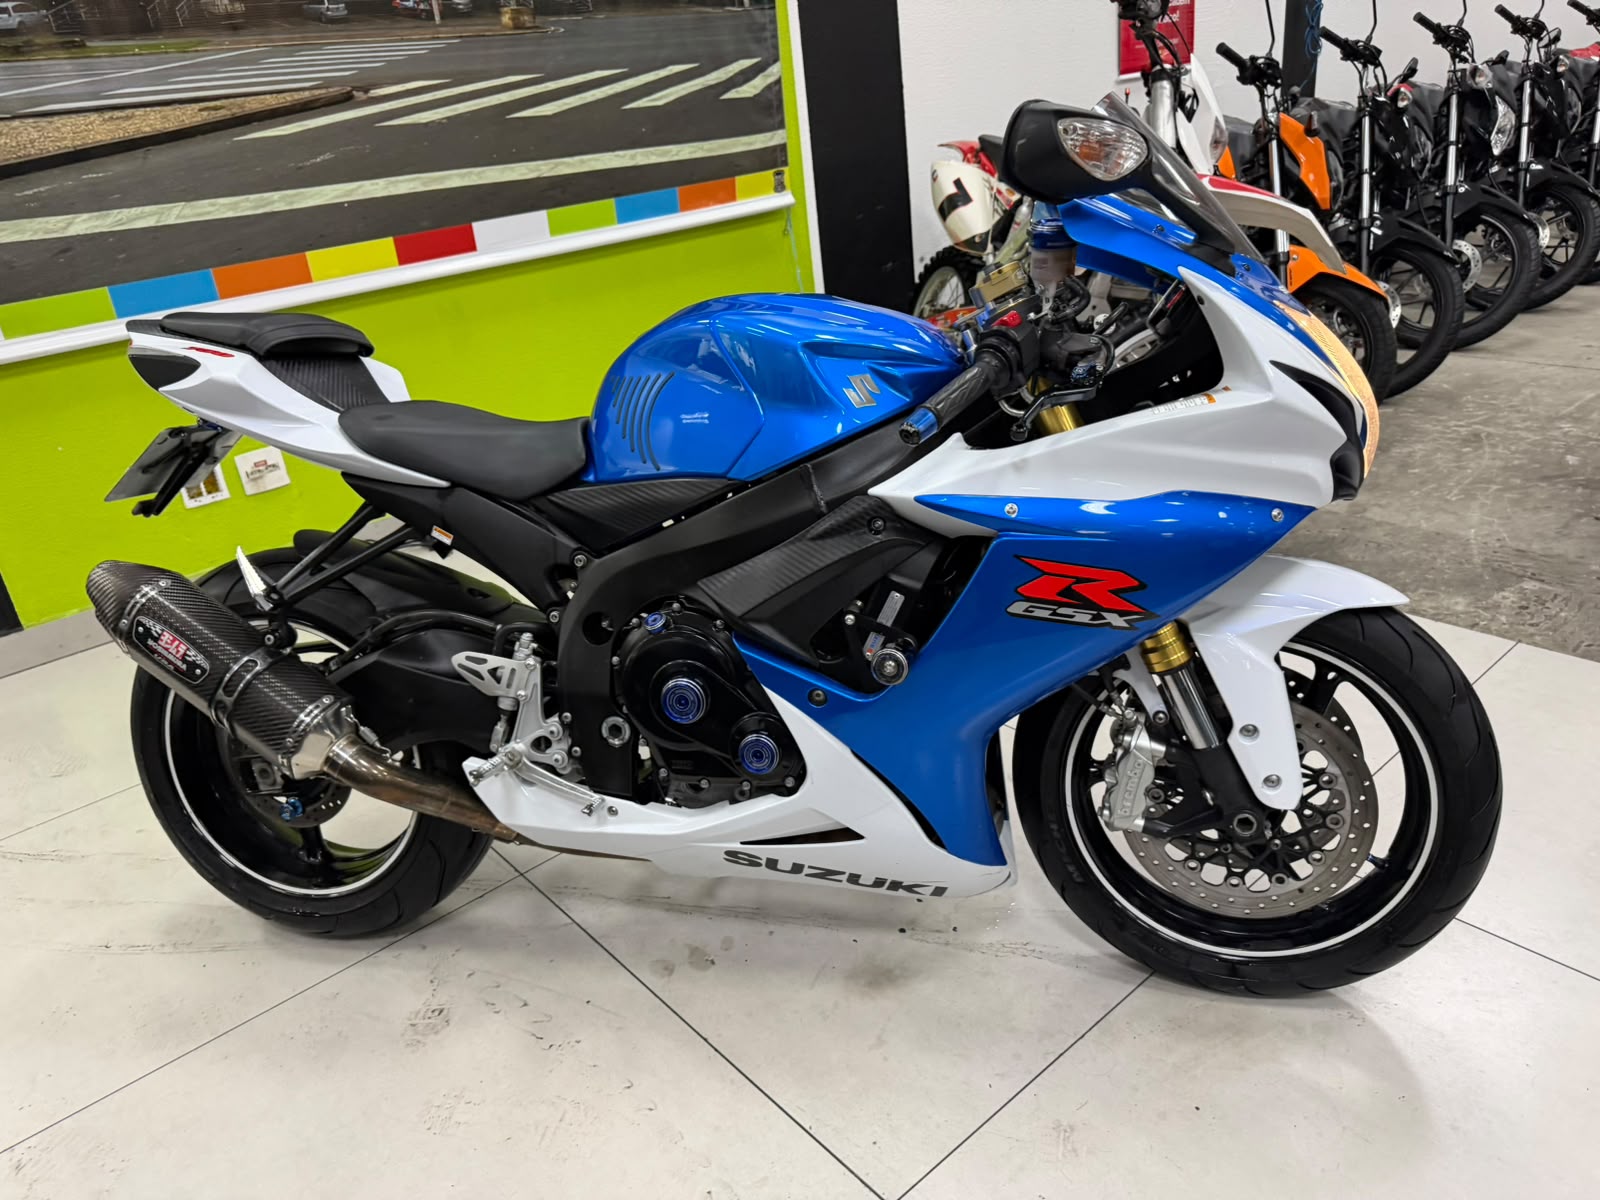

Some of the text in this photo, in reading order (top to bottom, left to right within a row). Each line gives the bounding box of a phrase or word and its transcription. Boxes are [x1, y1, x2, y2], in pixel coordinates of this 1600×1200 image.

[1006, 601, 1145, 628] GSX
[1117, 760, 1143, 816] brembo
[723, 850, 949, 897] SUZUKI
